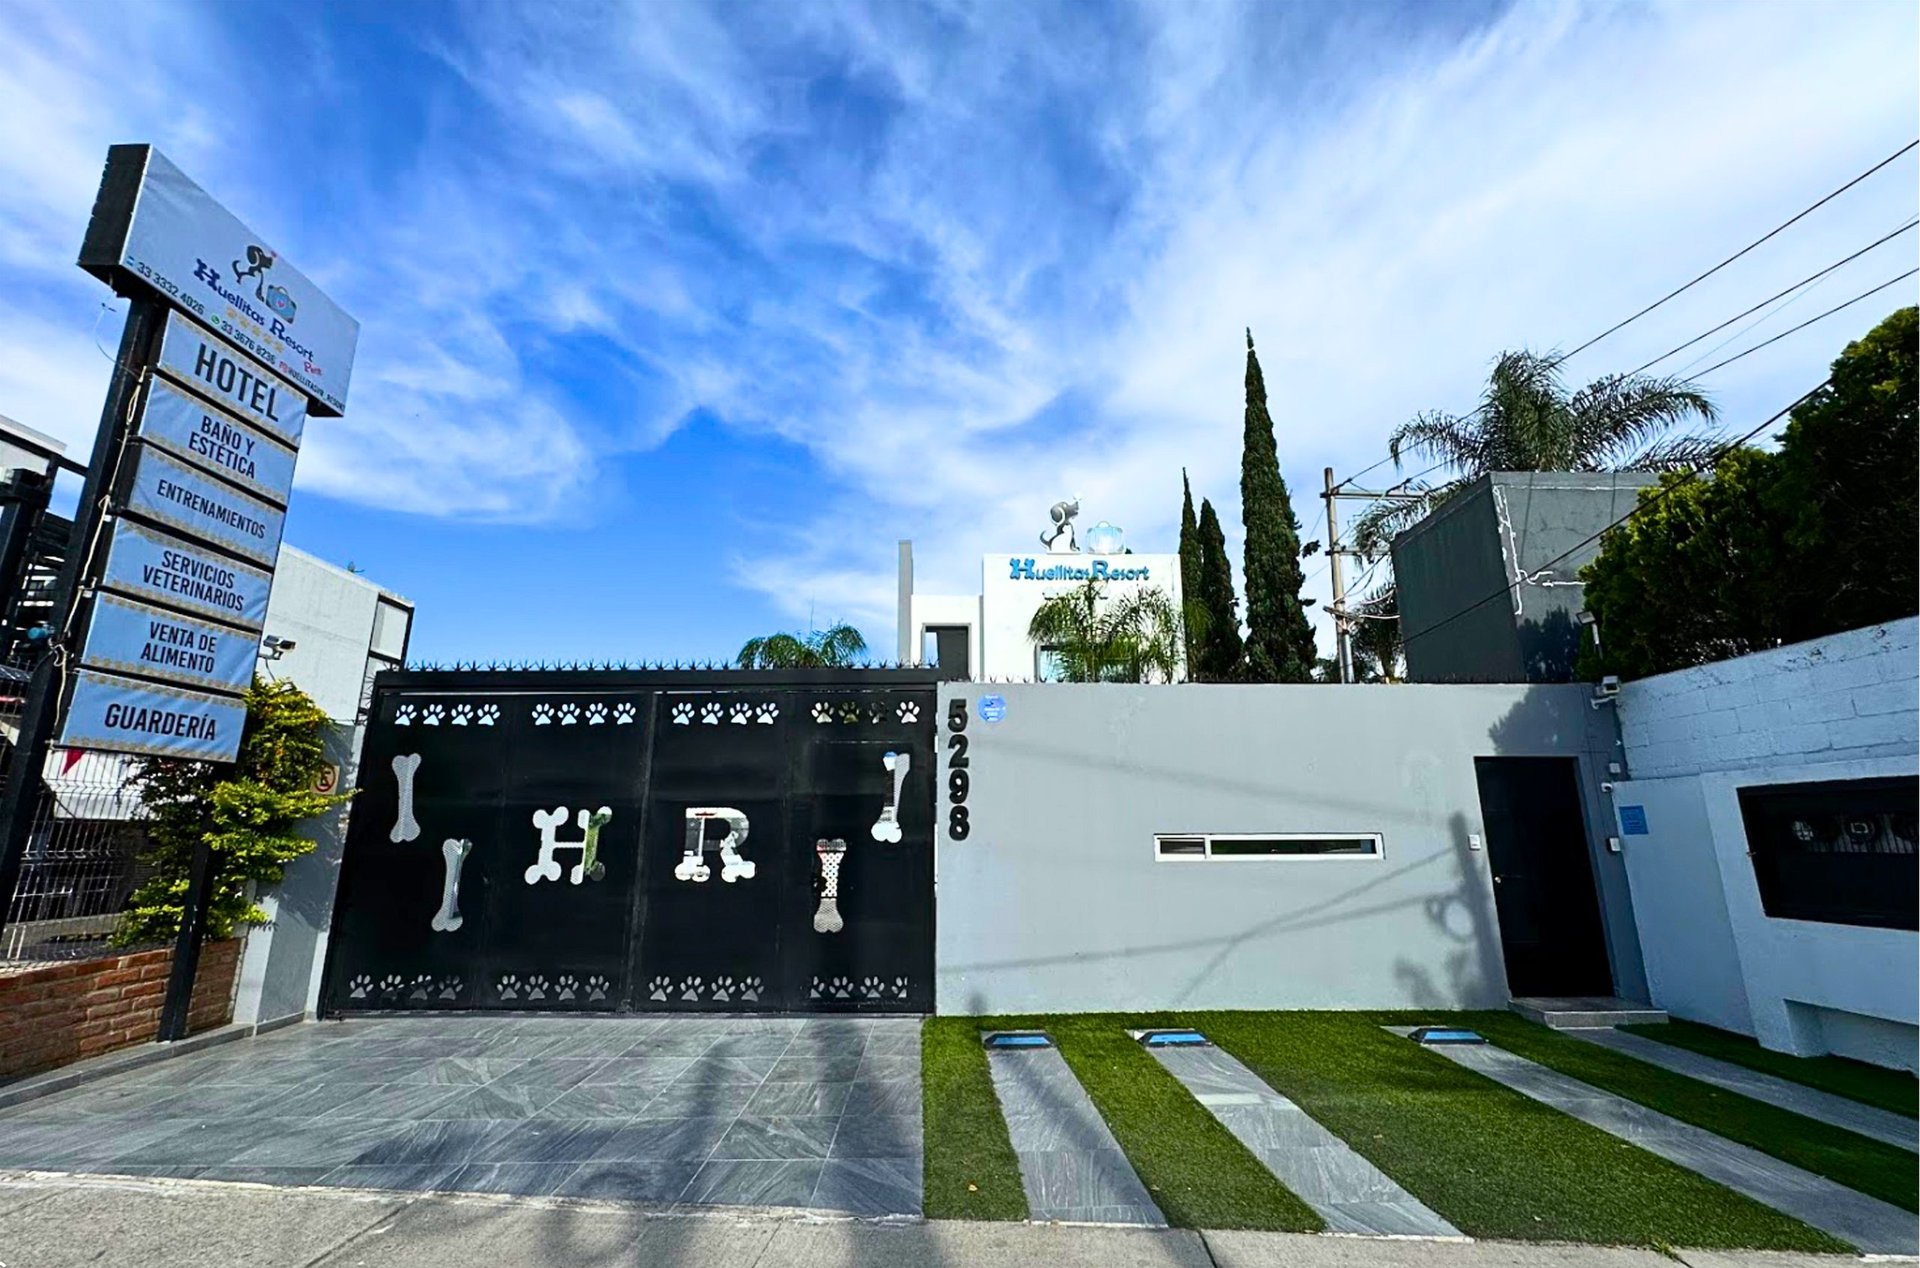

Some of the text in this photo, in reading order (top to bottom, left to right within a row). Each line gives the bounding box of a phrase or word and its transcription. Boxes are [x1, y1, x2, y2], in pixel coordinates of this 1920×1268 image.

[137, 261, 205, 315] 33 3332 4026
[193, 258, 314, 363] Huellitas Resort
[194, 343, 279, 422] HOTEL
[188, 432, 256, 479] ESTÉTICA
[201, 415, 256, 457] BAÑO Y
[156, 479, 266, 539] ENTRENAMIENTOS
[142, 565, 245, 612] VETERINARIOS
[161, 550, 235, 589] SERVICIOS
[1009, 558, 1149, 583] Huellitas Resort
[140, 642, 215, 674] ALIMENTO
[150, 621, 217, 654] VENTA DE
[104, 703, 217, 741] GUARDERÍA
[947, 698, 970, 841] 5298
[524, 806, 756, 885] H R
